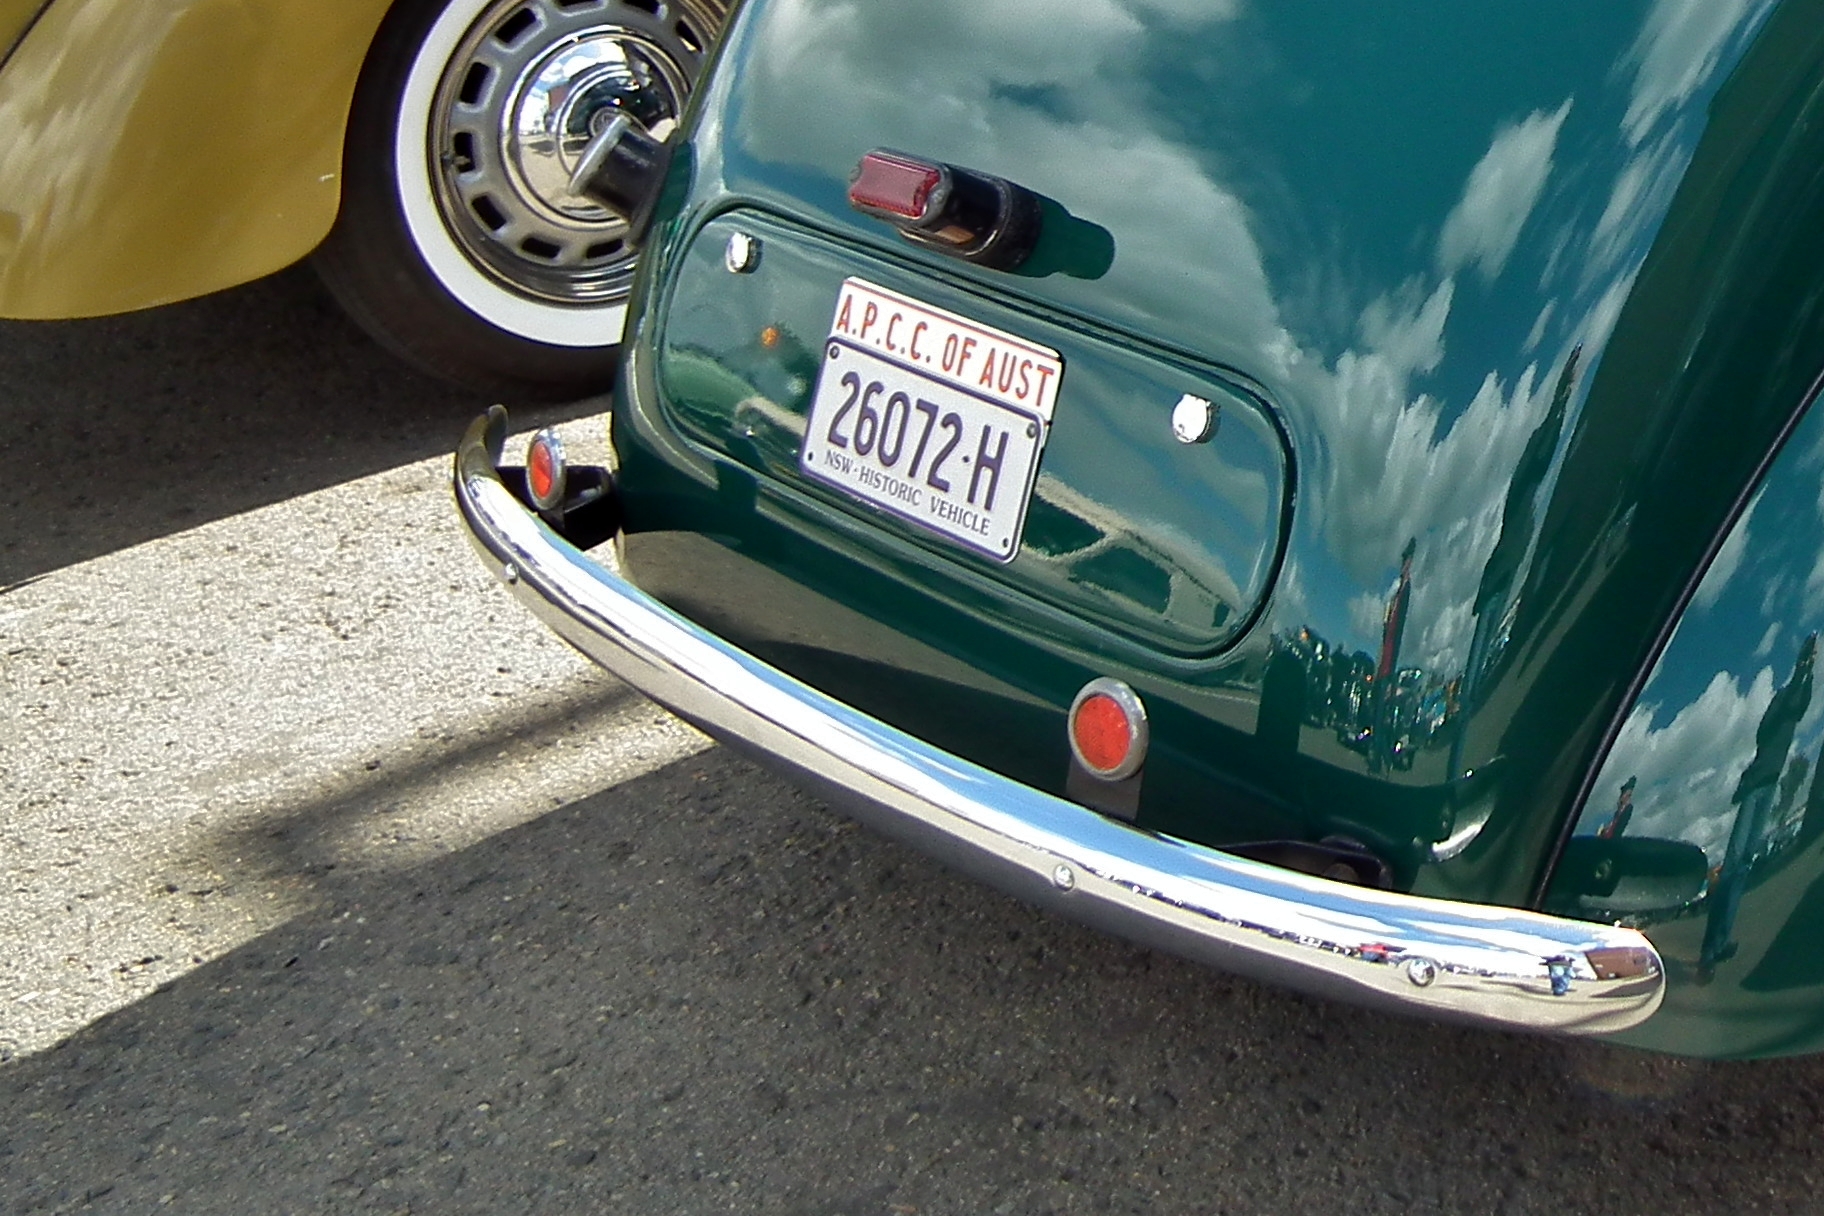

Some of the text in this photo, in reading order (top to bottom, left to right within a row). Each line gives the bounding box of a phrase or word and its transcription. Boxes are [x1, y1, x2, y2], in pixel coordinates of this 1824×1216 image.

[836, 293, 1055, 407] A.P.C.C. OF AUST
[930, 495, 992, 537] VEHICLE
